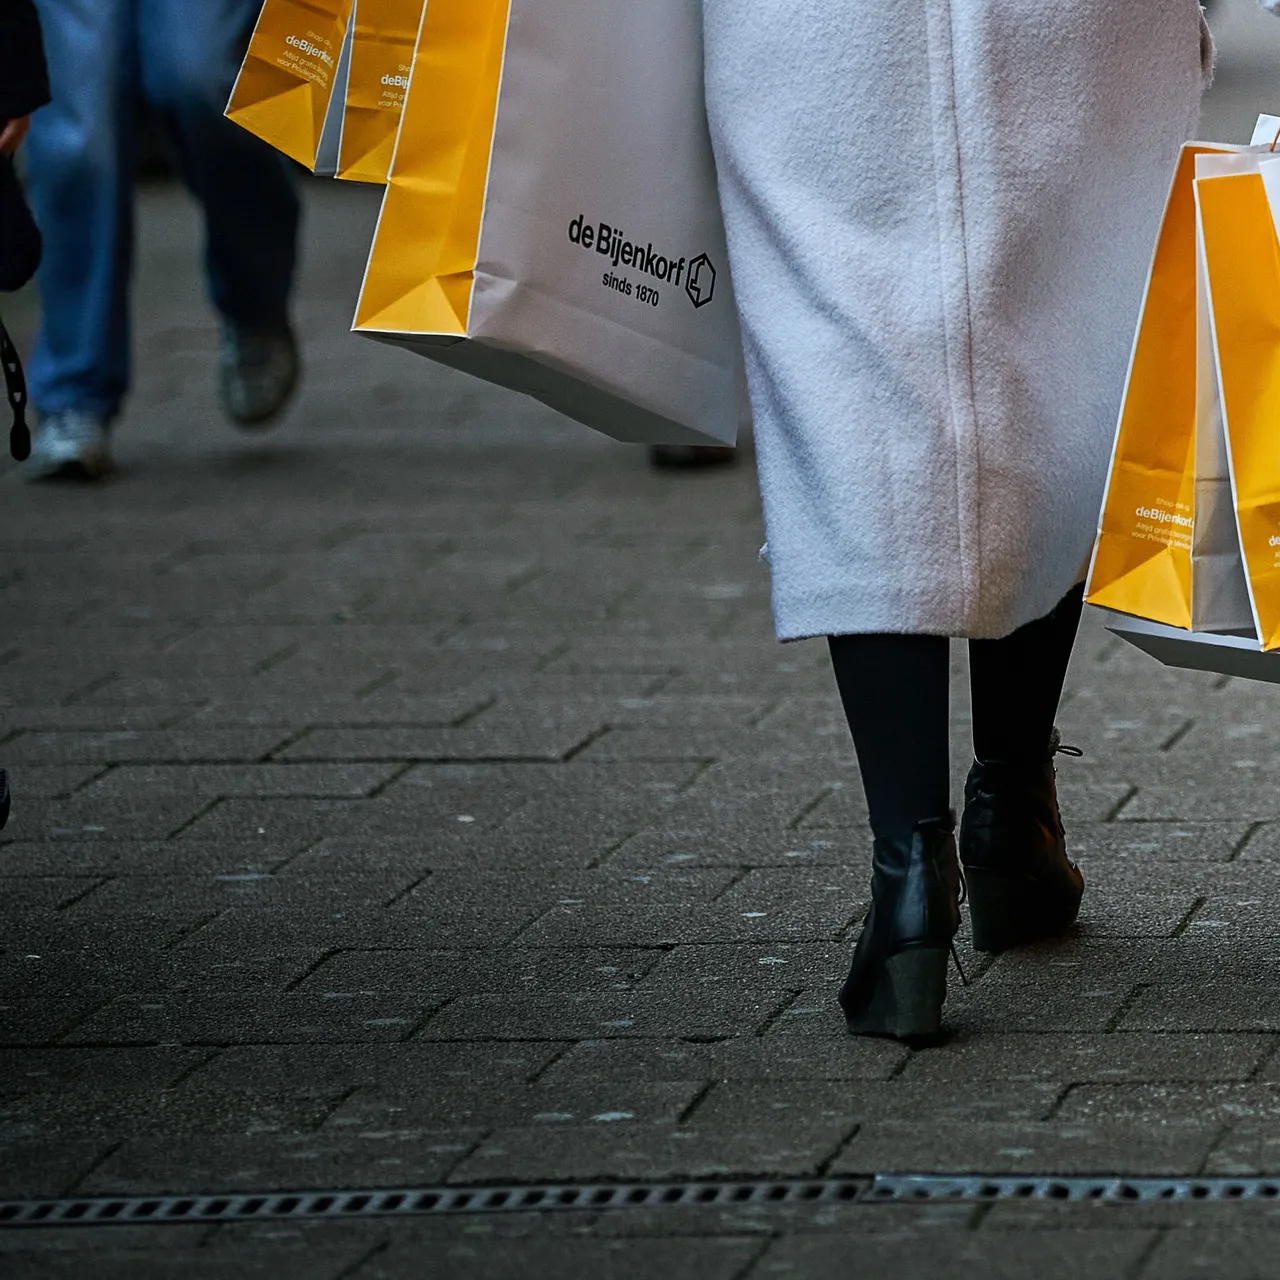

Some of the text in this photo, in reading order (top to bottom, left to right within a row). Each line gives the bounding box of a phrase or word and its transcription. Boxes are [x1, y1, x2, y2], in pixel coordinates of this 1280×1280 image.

[595, 222, 685, 286] Bijenkorf
[602, 272, 659, 307] sinds 1870
